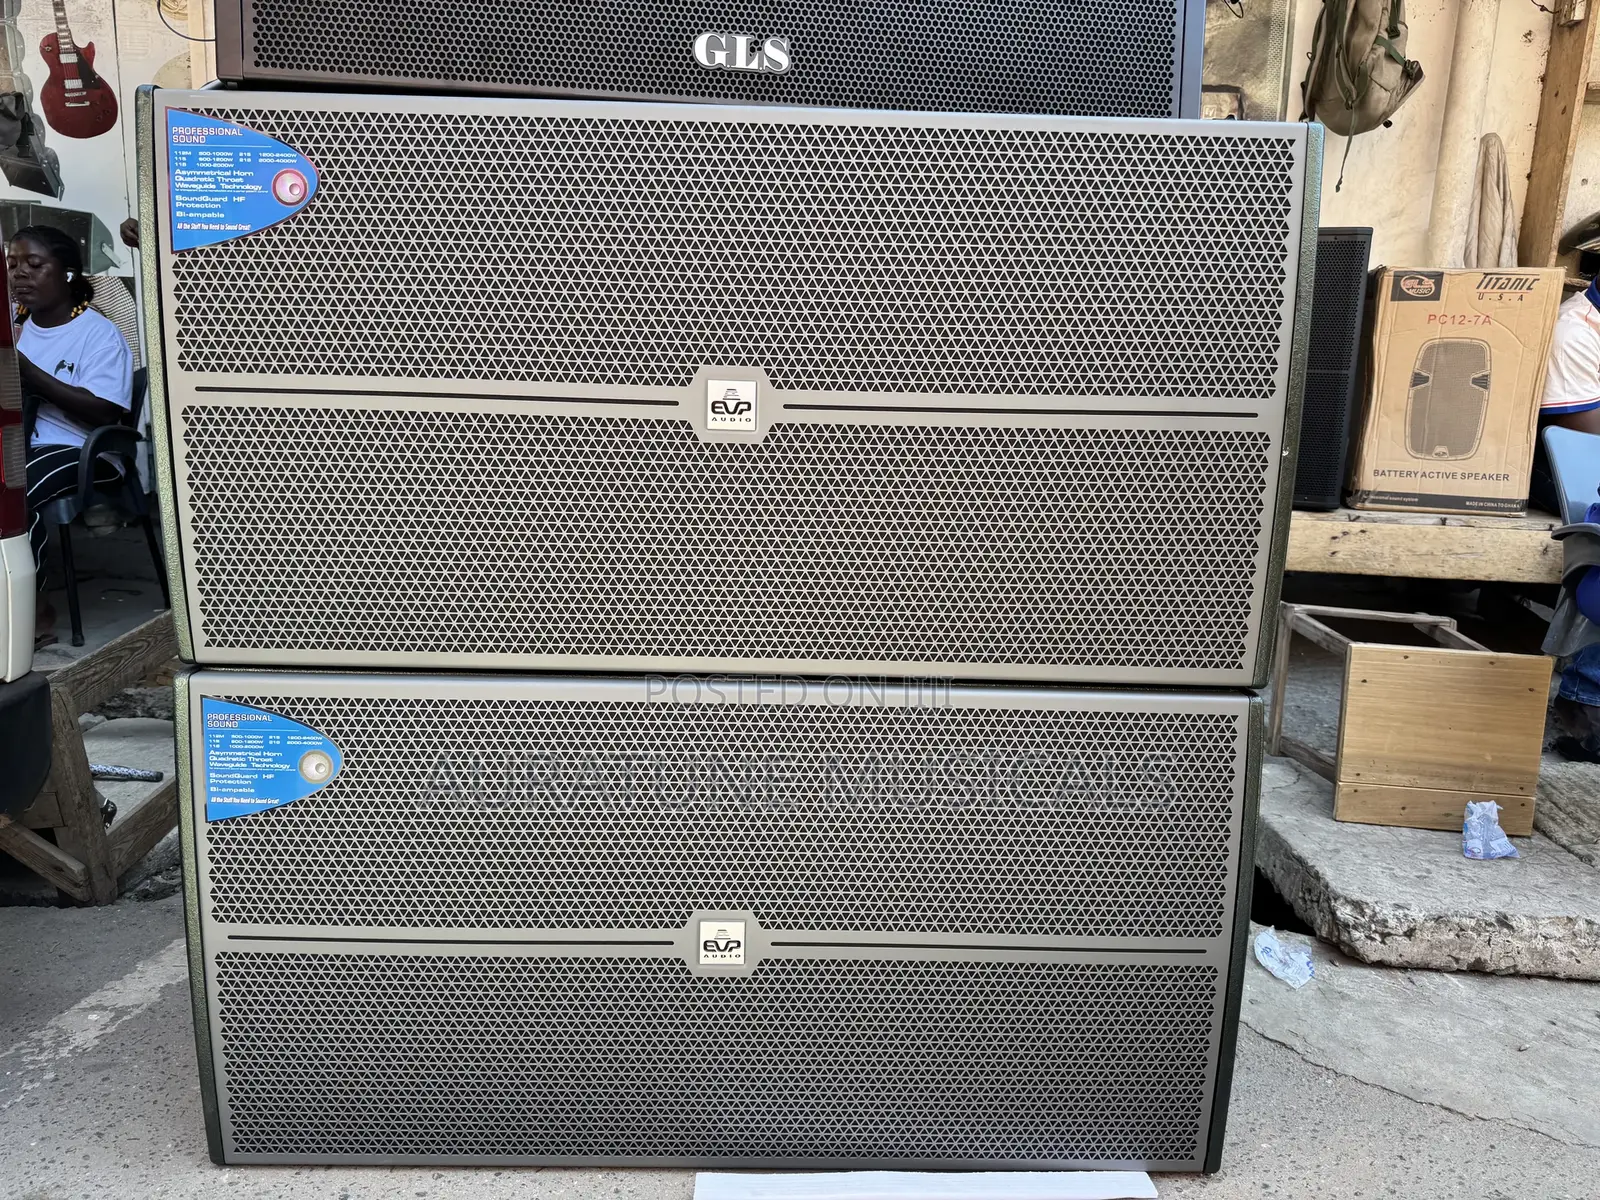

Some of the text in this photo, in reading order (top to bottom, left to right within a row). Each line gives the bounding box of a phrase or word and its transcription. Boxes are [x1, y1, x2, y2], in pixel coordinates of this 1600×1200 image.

[172, 126, 243, 136] PROFESSIONAL
[172, 135, 206, 144] SOUND
[174, 169, 231, 177] Asymmetrical
[1476, 272, 1540, 291] TITANIC
[1427, 314, 1492, 326] PC12-7A
[1373, 469, 1510, 482] BATTERY ACTIVE SPEAKER
[207, 714, 272, 722] PROFESSIONAL
